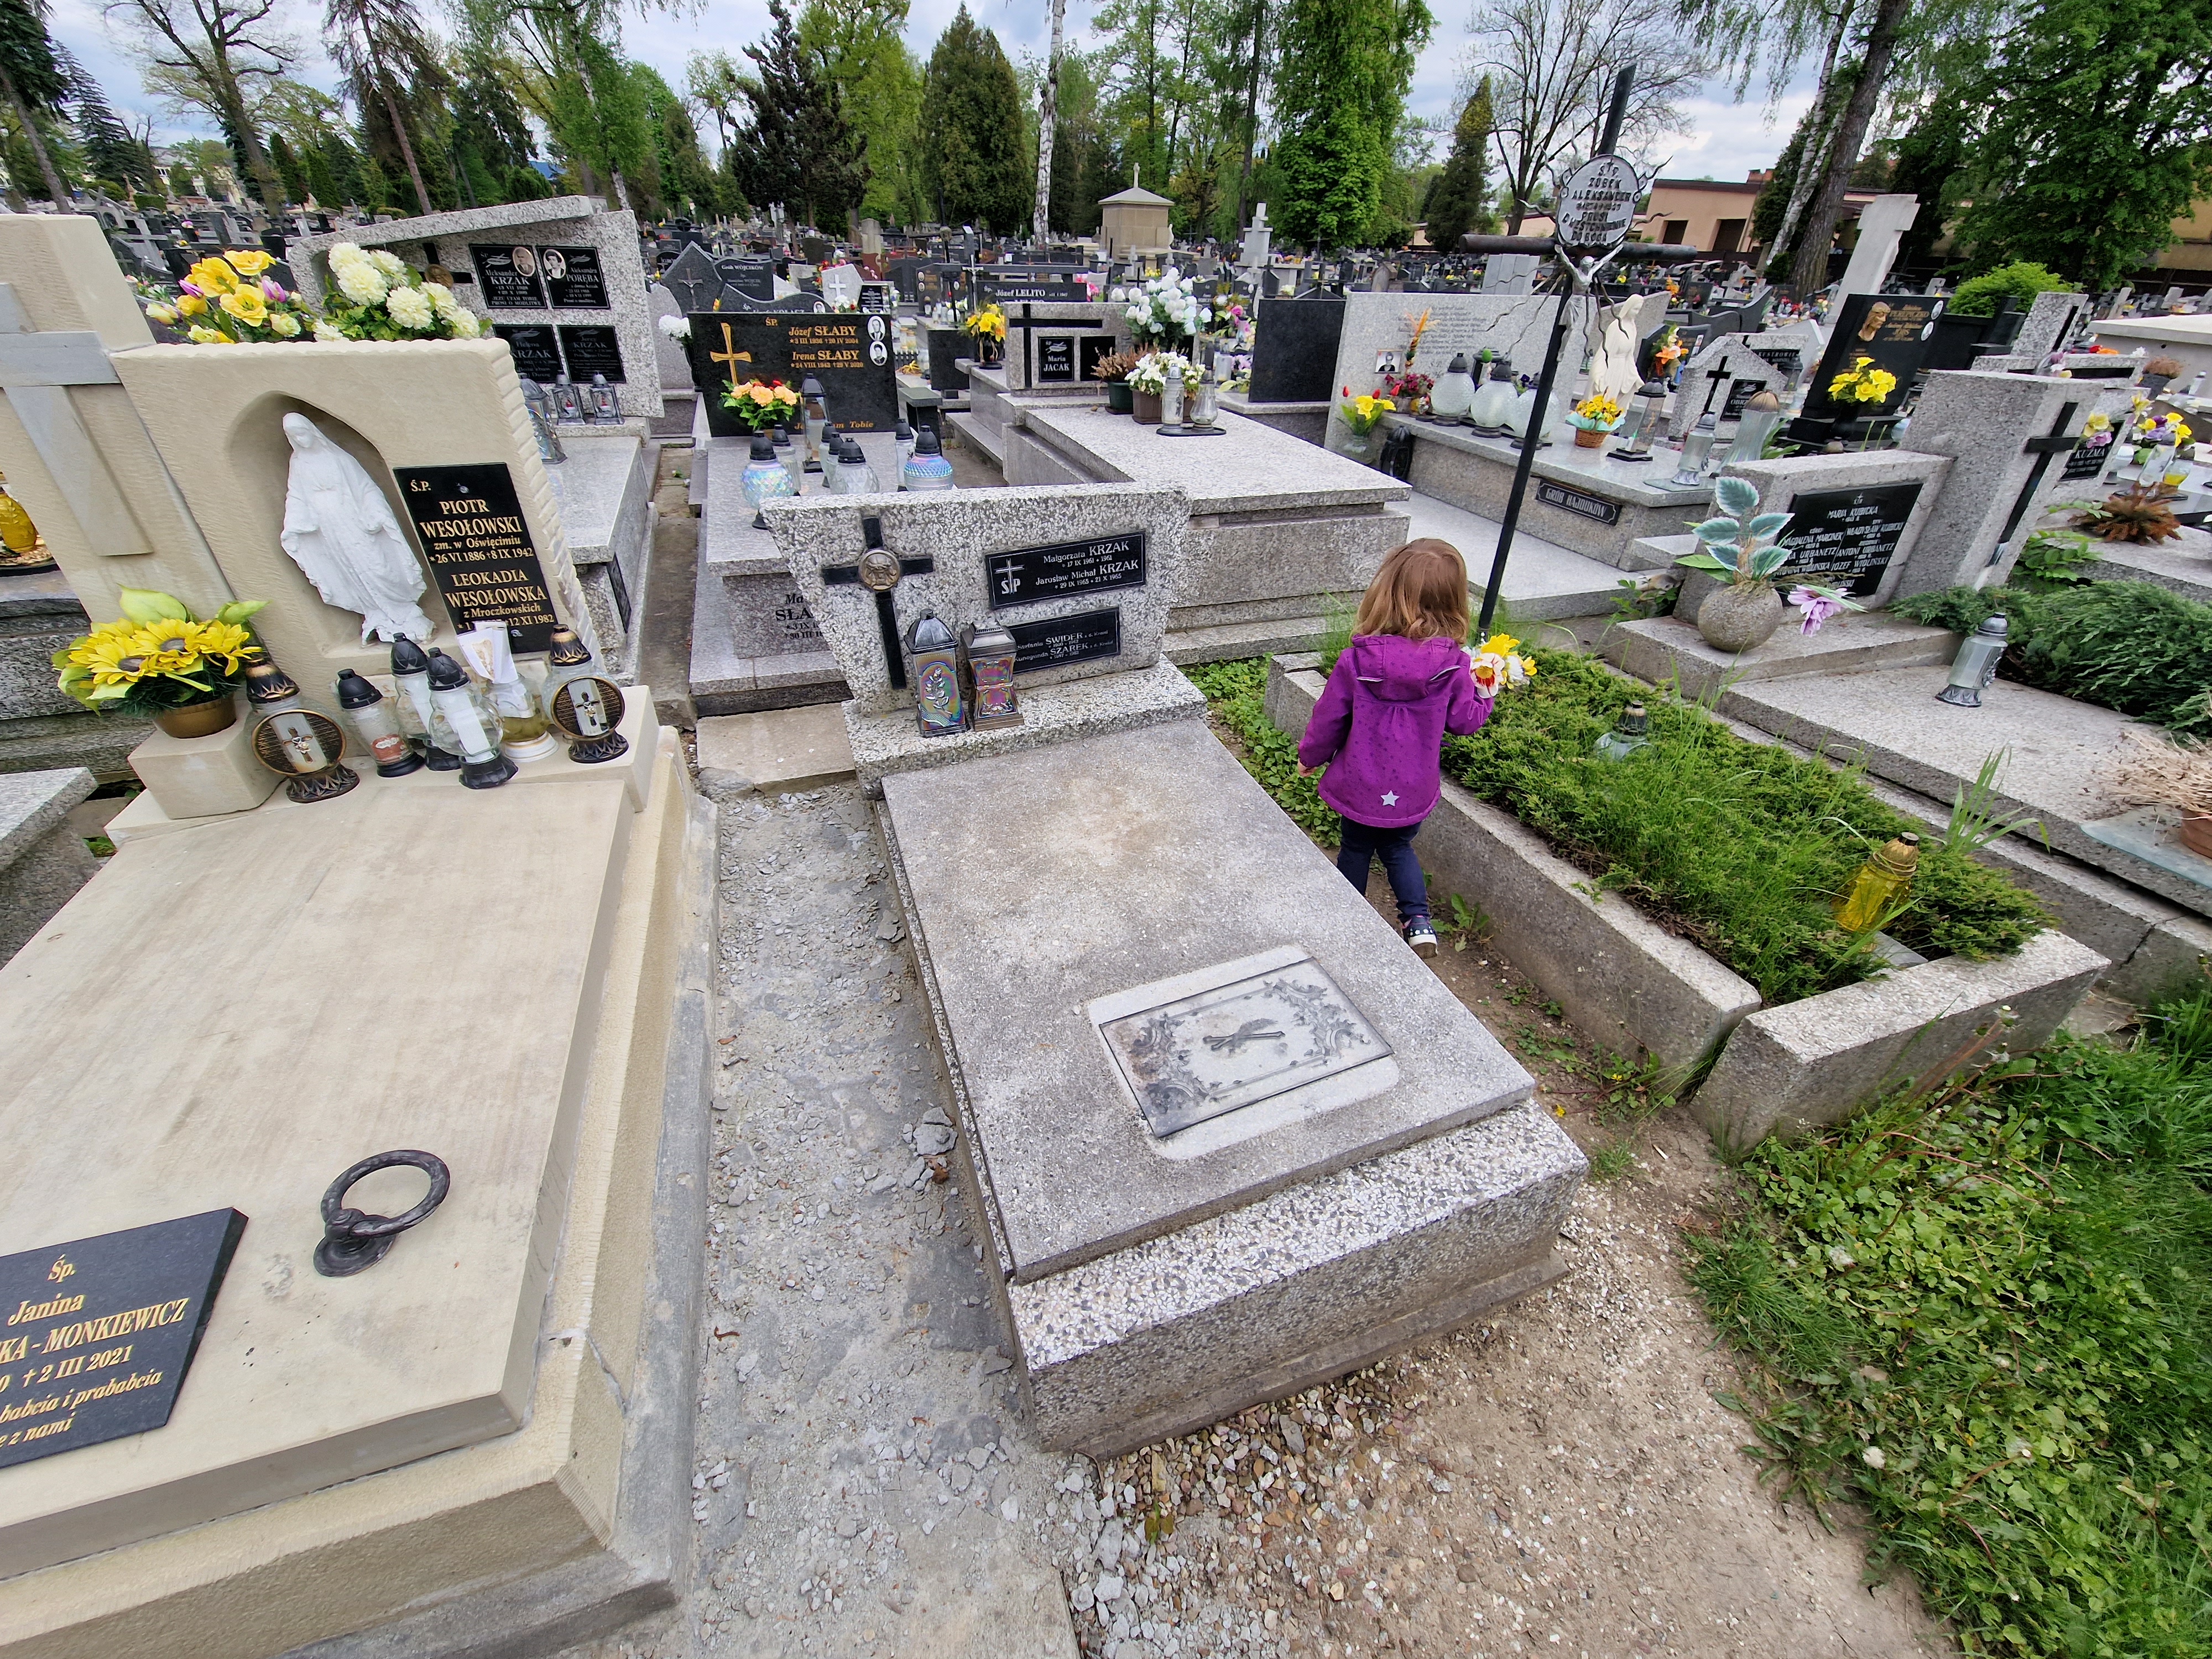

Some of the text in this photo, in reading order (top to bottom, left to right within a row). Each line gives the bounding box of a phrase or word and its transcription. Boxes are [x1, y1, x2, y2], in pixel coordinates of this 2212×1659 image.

[1588, 178, 1621, 189] ZUBEK
[490, 276, 530, 285] KRZAK
[1015, 289, 1046, 297] LELITO
[765, 317, 778, 326] ŚP.
[789, 326, 857, 337] Józef SŁABY
[792, 350, 859, 361] Irena SŁABY
[1043, 363, 1070, 372] JACAK
[410, 479, 431, 492] Ś.P.
[439, 499, 490, 515] PIOTR
[1546, 488, 1607, 518] GRÓB HAJDUKÓW
[1827, 506, 1879, 519] MARIA KUBICKA
[419, 516, 523, 539] WESOŁOWSKI
[434, 536, 521, 550] zm. w Oświęcimiu
[436, 554, 448, 564] 26
[451, 552, 462, 563] VI
[465, 551, 486, 562] 1886
[499, 549, 512, 559] IX
[512, 547, 534, 558] 1942
[1043, 541, 1129, 564] Małgorzata KRZAK
[1799, 547, 1837, 559] URBANETZ
[1837, 547, 1861, 557] ANTONI
[451, 569, 529, 587] LEOKADIA
[1035, 560, 1139, 586] Jarosław Michał KRZAK
[444, 586, 547, 608] WESOŁOWSKA
[471, 602, 541, 618] Mroczkowskich
[775, 607, 815, 622] SŁA
[508, 614, 555, 627] 12 XI 1982
[1015, 651, 1048, 662] Kunegunda
[1050, 643, 1089, 656] SZAREK
[1017, 641, 1044, 650] Stefania
[47, 1254, 76, 1283] Śp.
[7, 1292, 86, 1327] Janina
[36, 1364, 54, 1384] 2
[54, 1354, 86, 1380] III
[85, 1344, 134, 1371] 2021
[0, 1368, 164, 1425] babcia i prababcia
[7, 1411, 77, 1446] z nami
